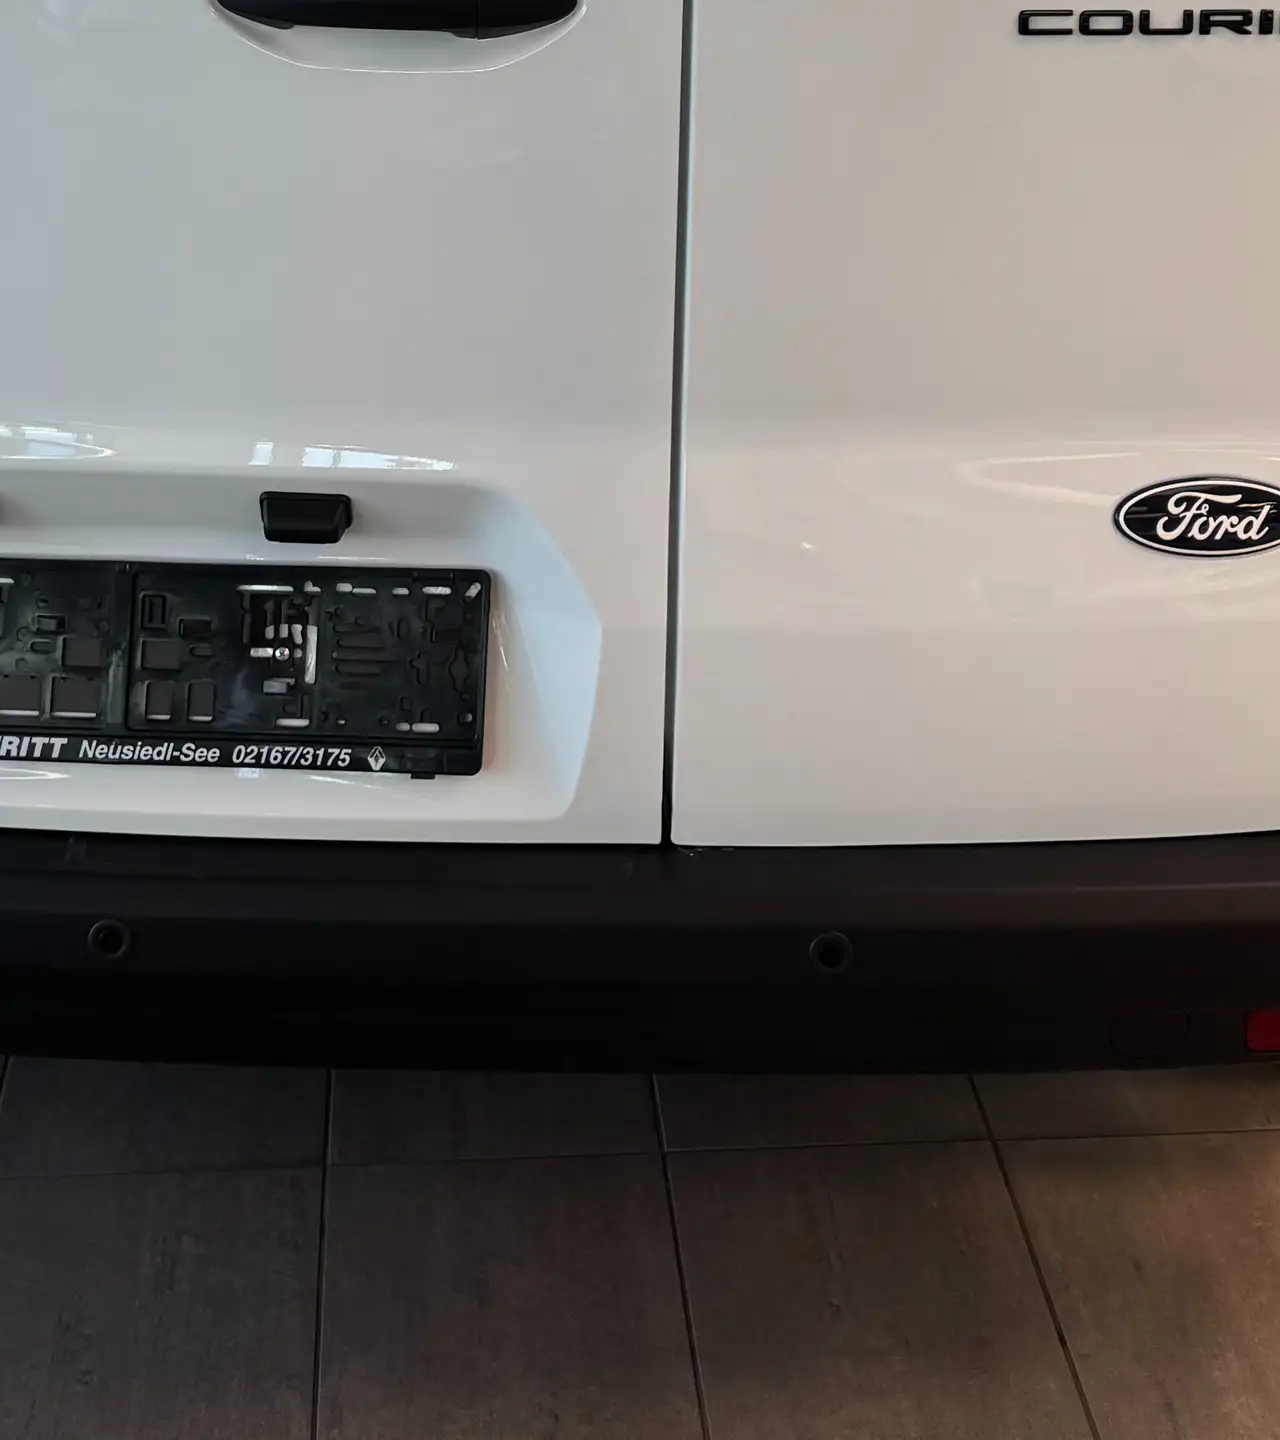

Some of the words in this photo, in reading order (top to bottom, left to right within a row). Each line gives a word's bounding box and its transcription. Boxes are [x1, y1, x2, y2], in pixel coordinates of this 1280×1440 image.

[1156, 491, 1270, 541] Ford
[78, 739, 220, 763] Neusiedl-See
[231, 745, 353, 768] 02167/3175
